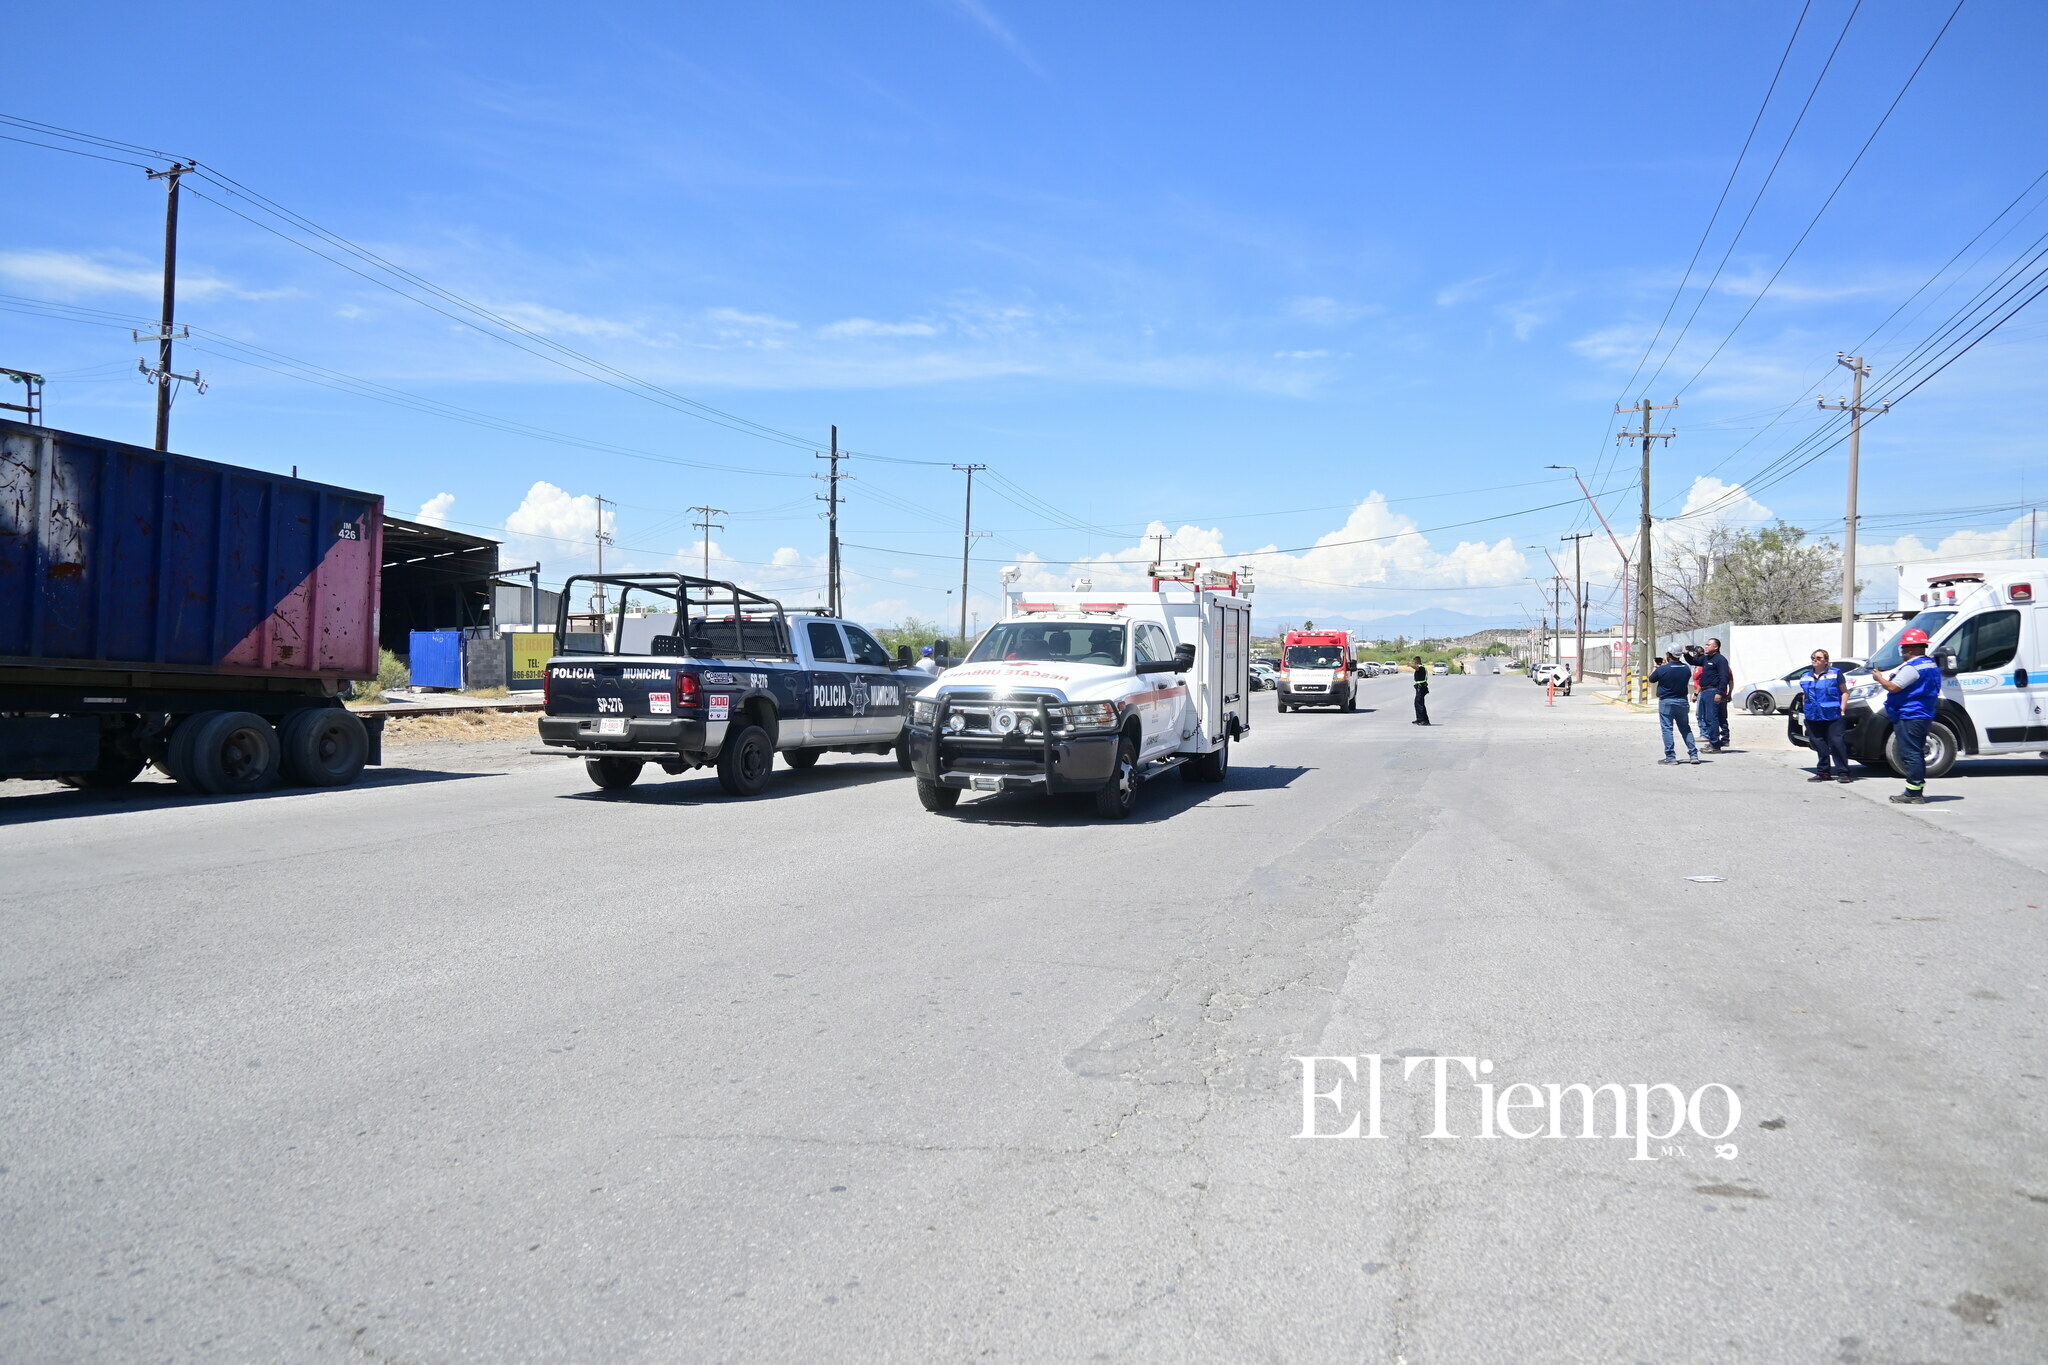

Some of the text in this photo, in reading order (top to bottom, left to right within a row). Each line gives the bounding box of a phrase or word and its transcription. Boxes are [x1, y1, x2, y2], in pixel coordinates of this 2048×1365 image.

[343, 522, 352, 530] IM
[338, 529, 356, 540] 426
[514, 638, 524, 651] SE
[527, 659, 540, 668] TEL:
[552, 667, 671, 680] POLICIA MUNICIPAL
[750, 673, 768, 689] SP-276
[1946, 678, 1990, 687] METELMEX
[711, 697, 728, 706] 911
[813, 685, 900, 707] POLICIA MUNICIPAL
[597, 698, 624, 713] SP-276
